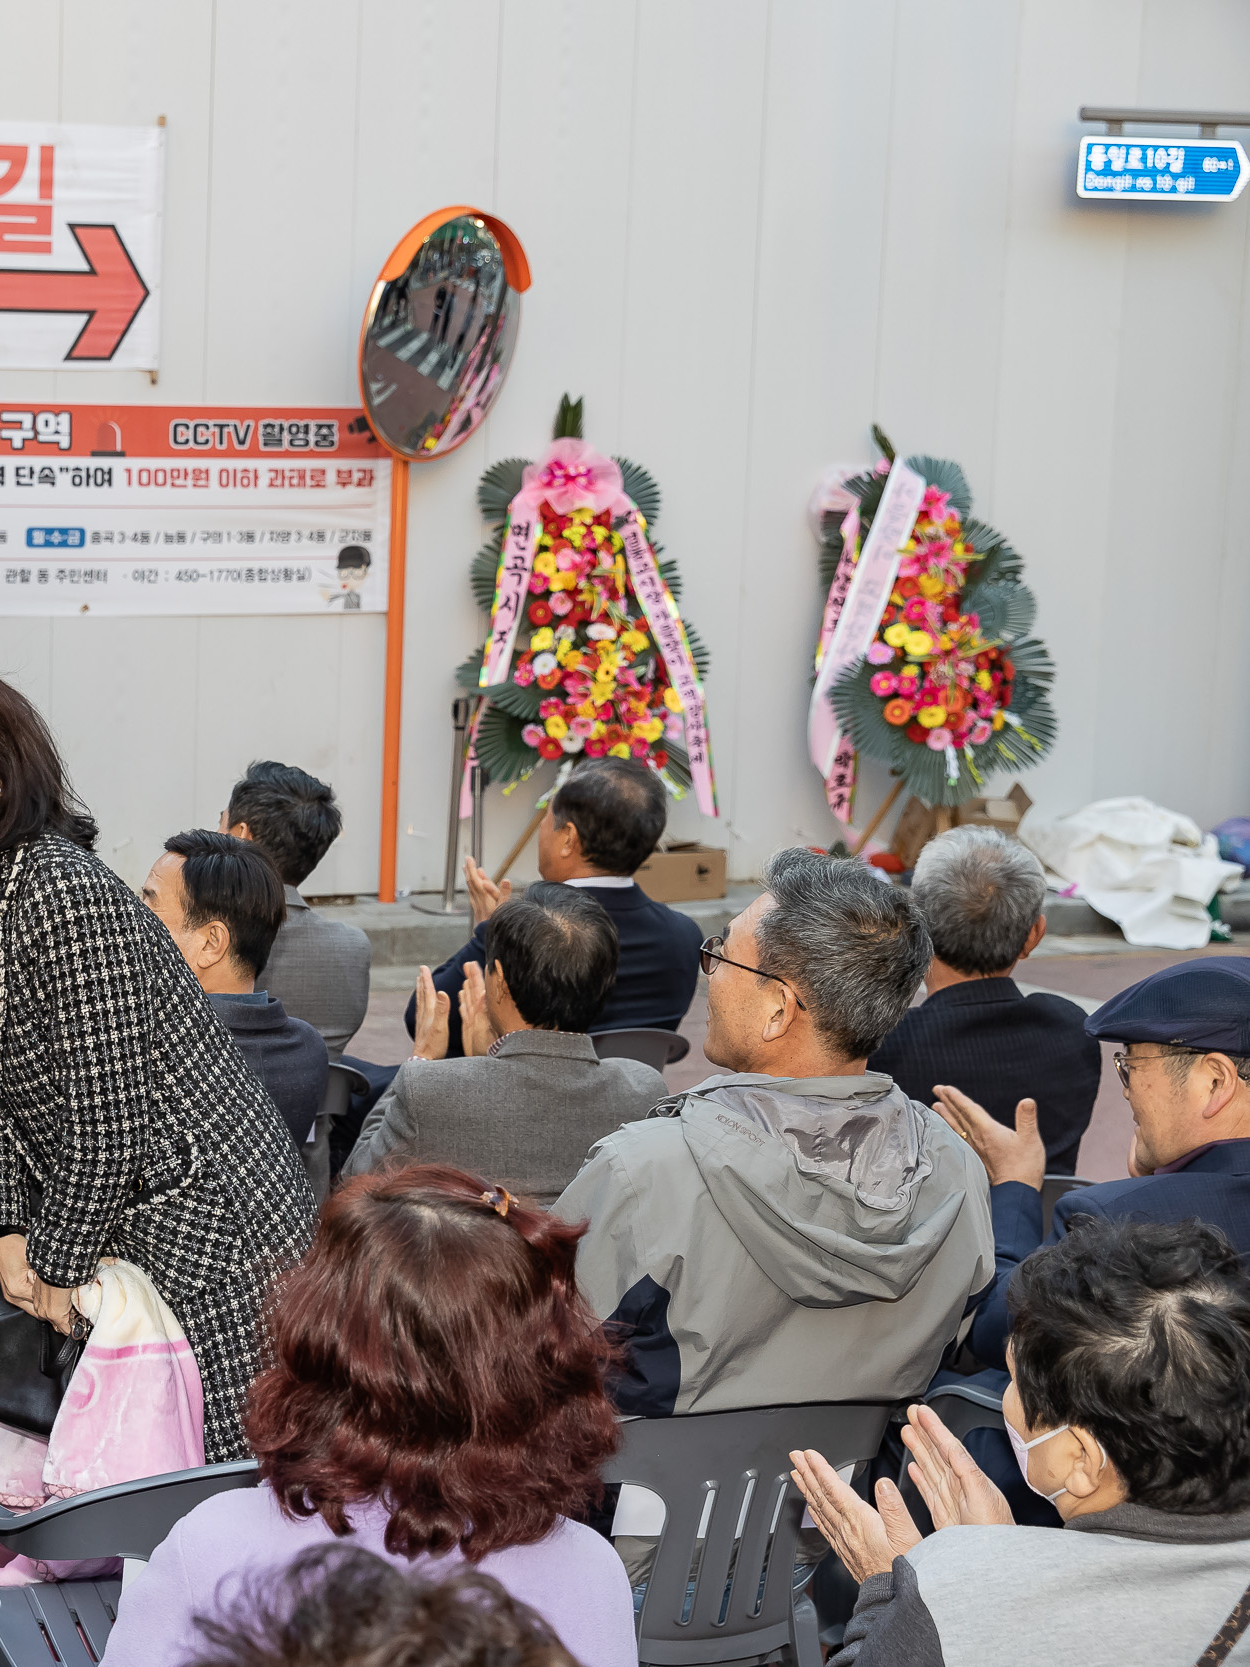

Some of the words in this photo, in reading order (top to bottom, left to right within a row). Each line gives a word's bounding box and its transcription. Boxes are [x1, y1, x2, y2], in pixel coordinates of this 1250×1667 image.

[0, 410, 73, 450] 구역
[172, 422, 251, 447] CCTV
[260, 421, 337, 449] 촬영중
[124, 467, 210, 489] 100만원
[218, 468, 259, 488] 이하
[267, 468, 327, 489] 과태료
[335, 469, 375, 489] 부과
